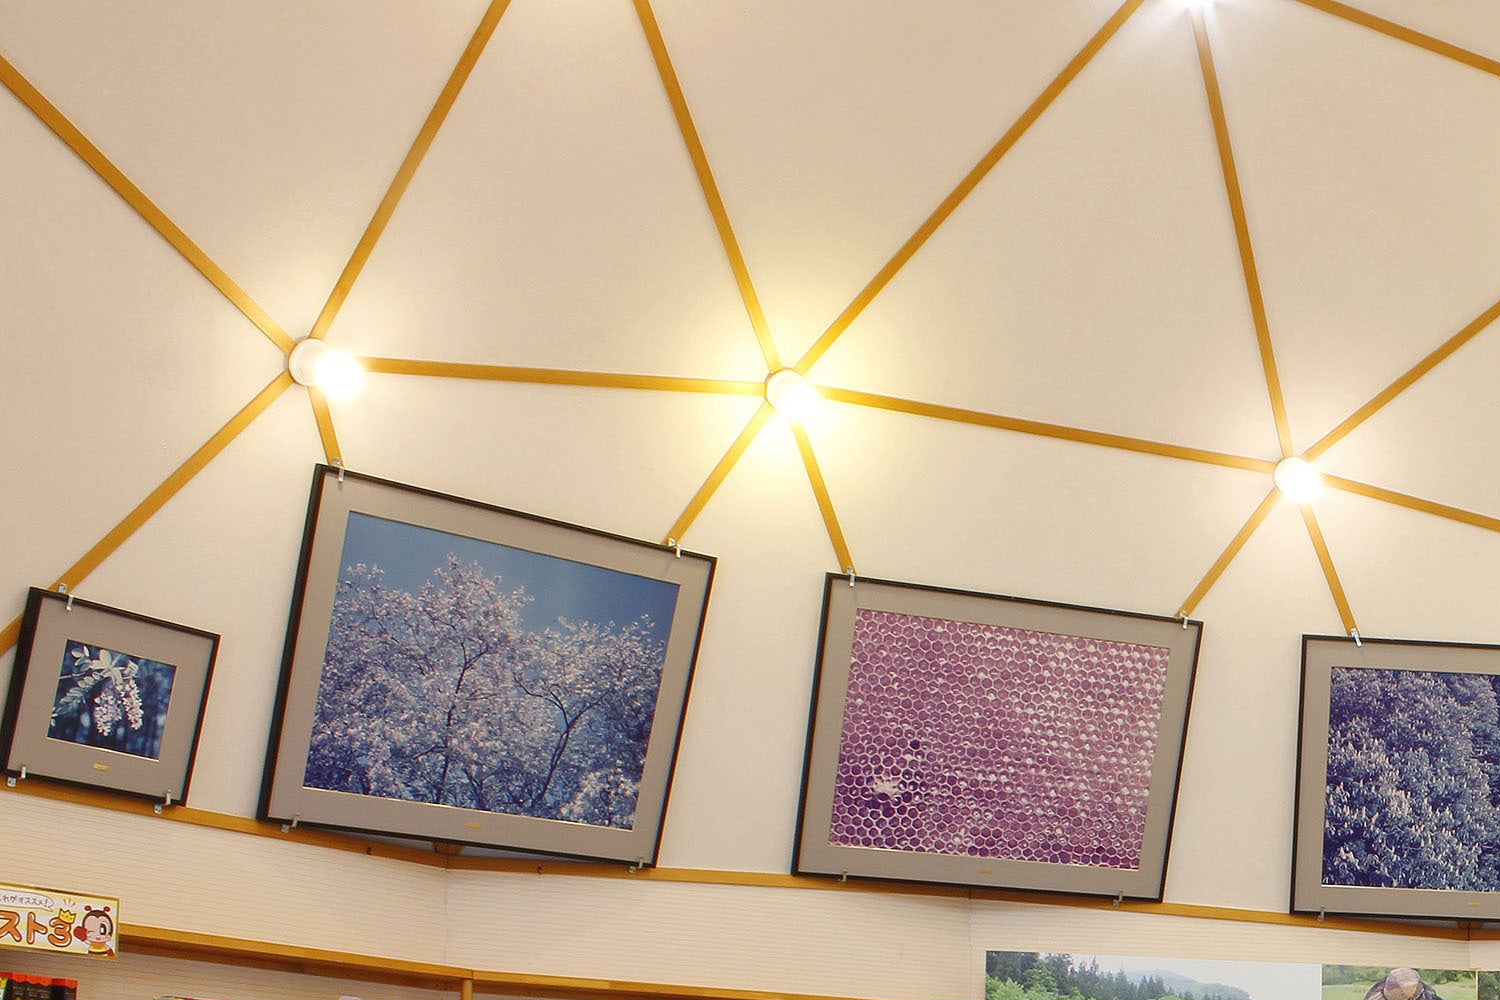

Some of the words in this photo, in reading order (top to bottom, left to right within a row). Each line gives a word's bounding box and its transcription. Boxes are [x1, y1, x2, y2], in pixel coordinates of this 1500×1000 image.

[0, 894, 49, 908] れがオススメ!
